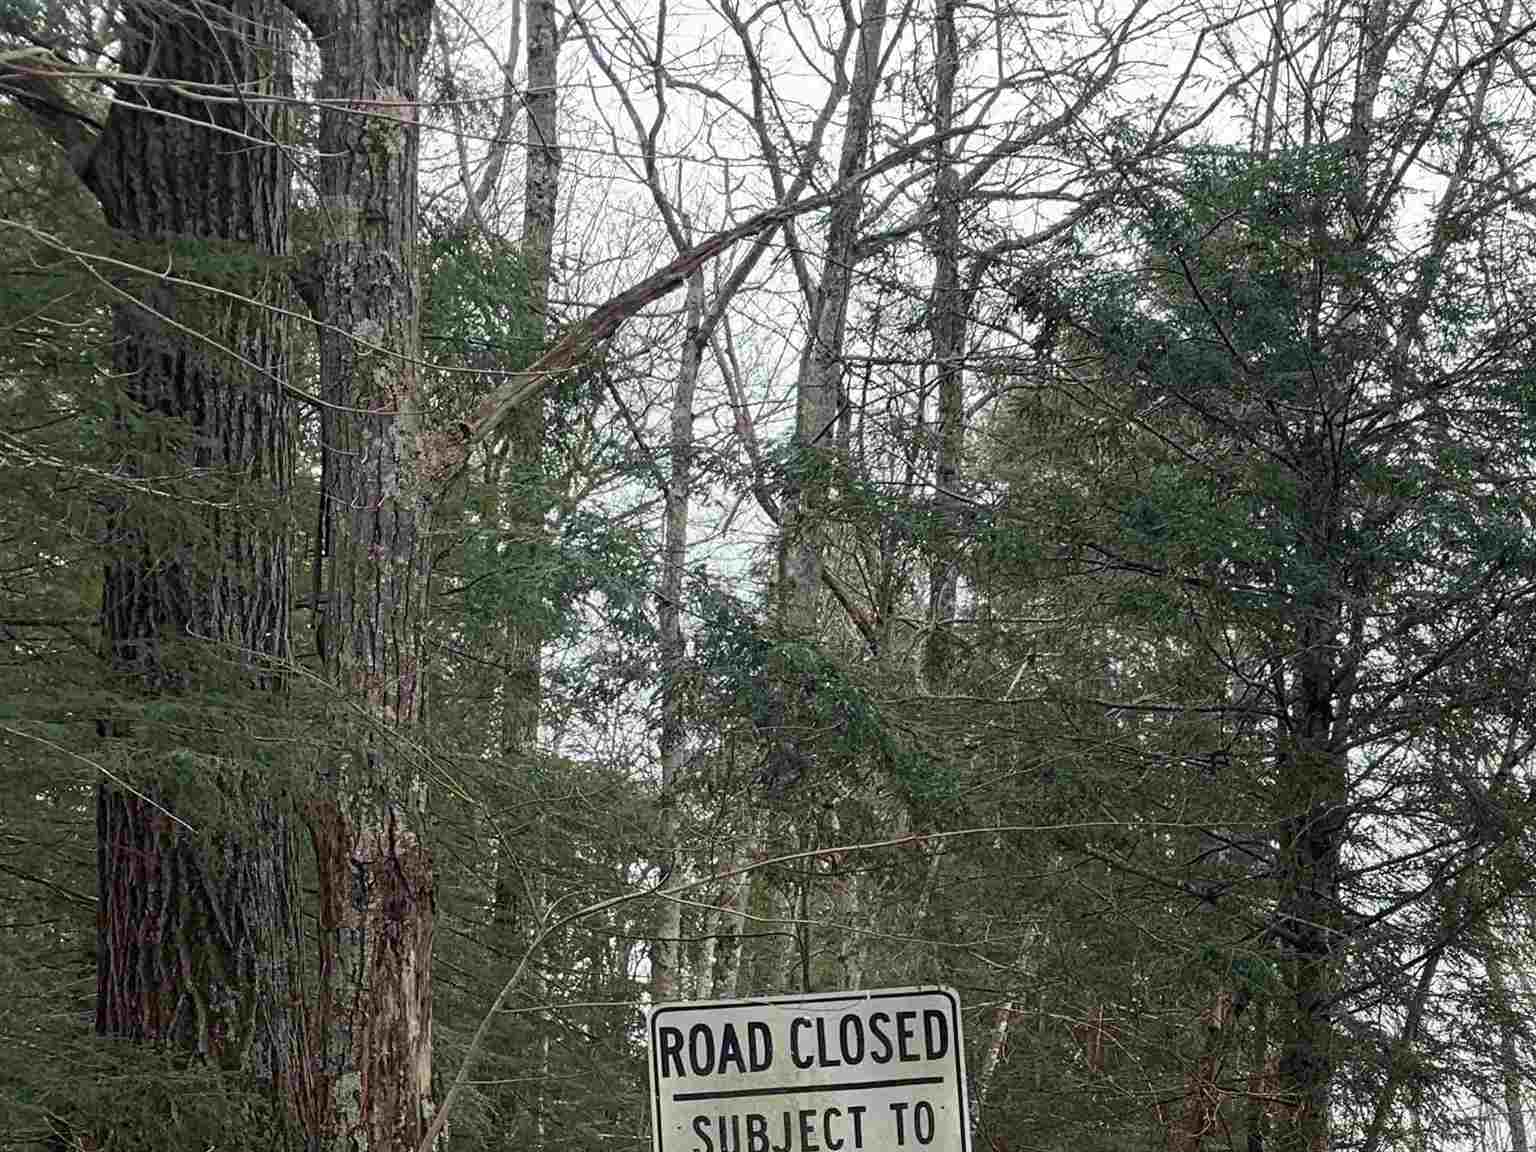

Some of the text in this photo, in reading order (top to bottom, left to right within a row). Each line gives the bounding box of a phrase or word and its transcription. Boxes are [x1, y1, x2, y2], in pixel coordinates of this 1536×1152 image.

[659, 1009, 949, 1078] ROAD CLOSED
[889, 1101, 935, 1146] TO
